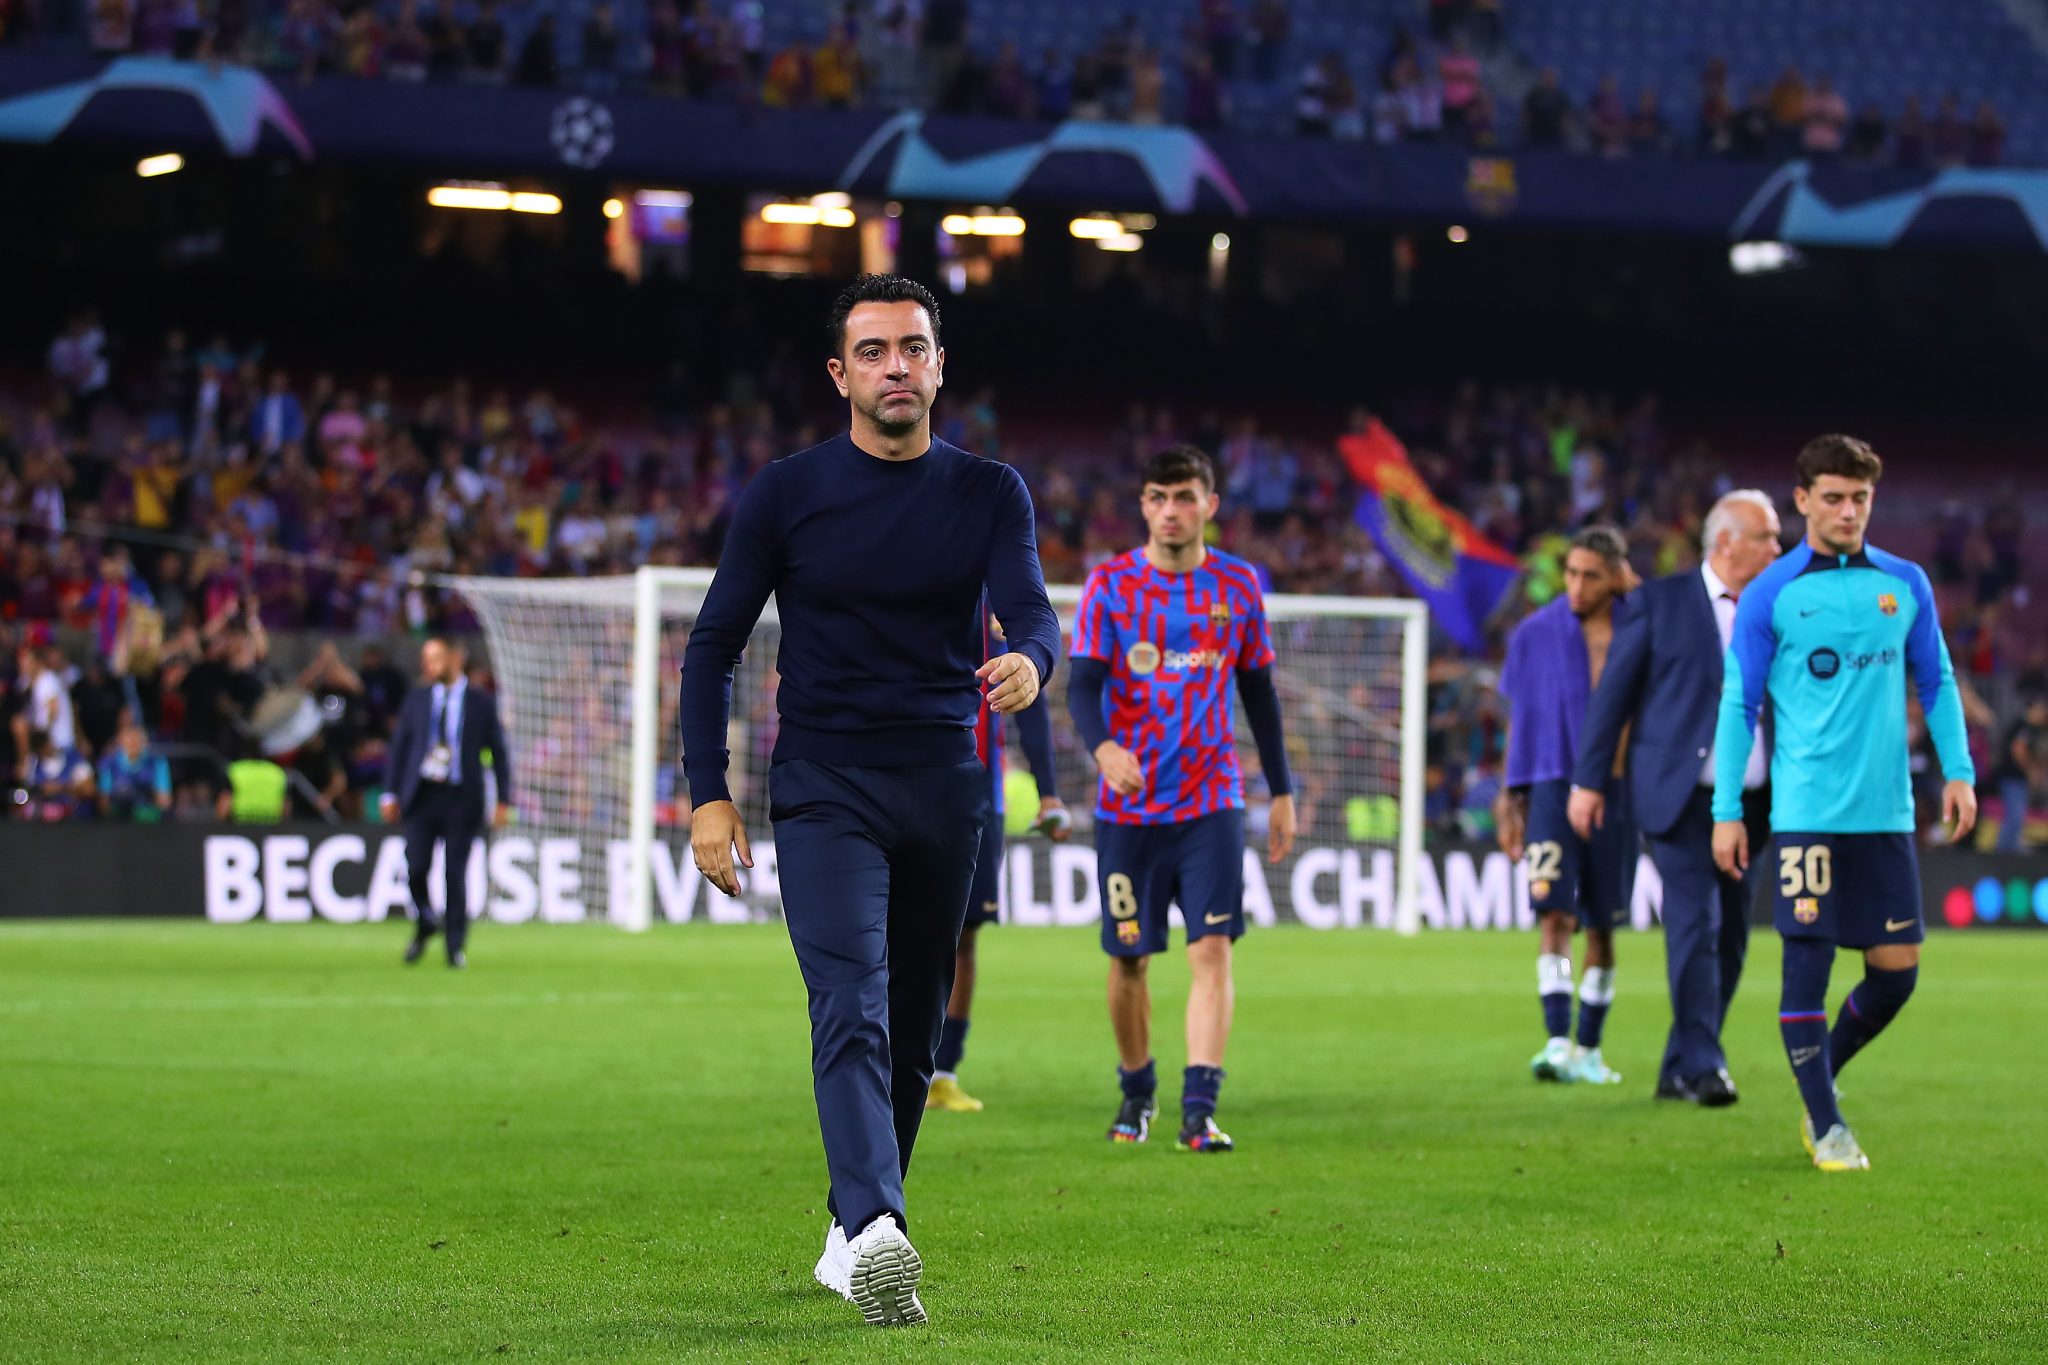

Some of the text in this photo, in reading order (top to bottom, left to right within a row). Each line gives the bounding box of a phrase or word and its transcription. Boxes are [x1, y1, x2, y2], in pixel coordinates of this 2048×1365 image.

[204, 834, 586, 924] BECAUSE
[1106, 872, 1138, 920] 8
[1779, 844, 1832, 898] 30
